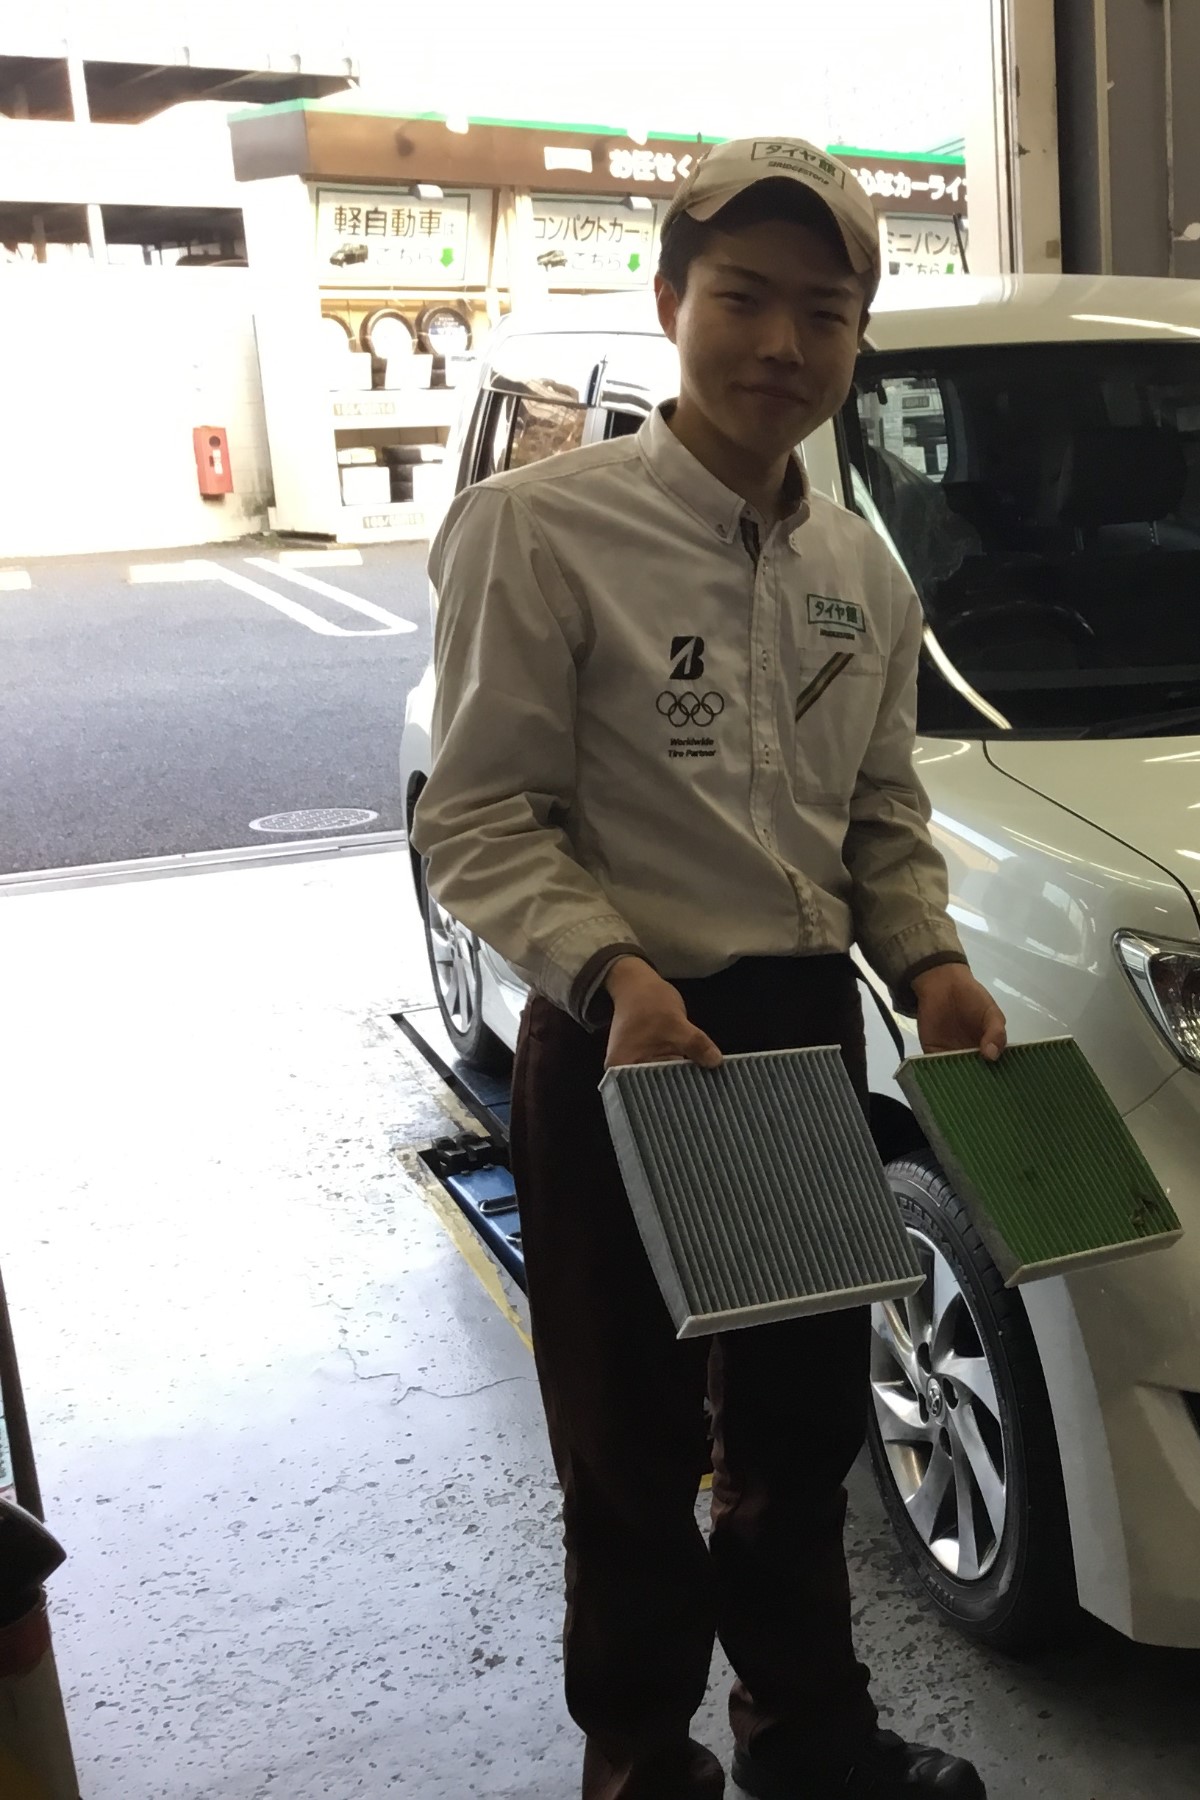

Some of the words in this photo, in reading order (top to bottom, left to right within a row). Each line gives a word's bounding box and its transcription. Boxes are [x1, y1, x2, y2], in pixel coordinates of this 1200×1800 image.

[609, 148, 702, 182] お任せく
[670, 737, 714, 746] Worldwide
[668, 749, 684, 758] Tire
[686, 749, 716, 758] Partner
